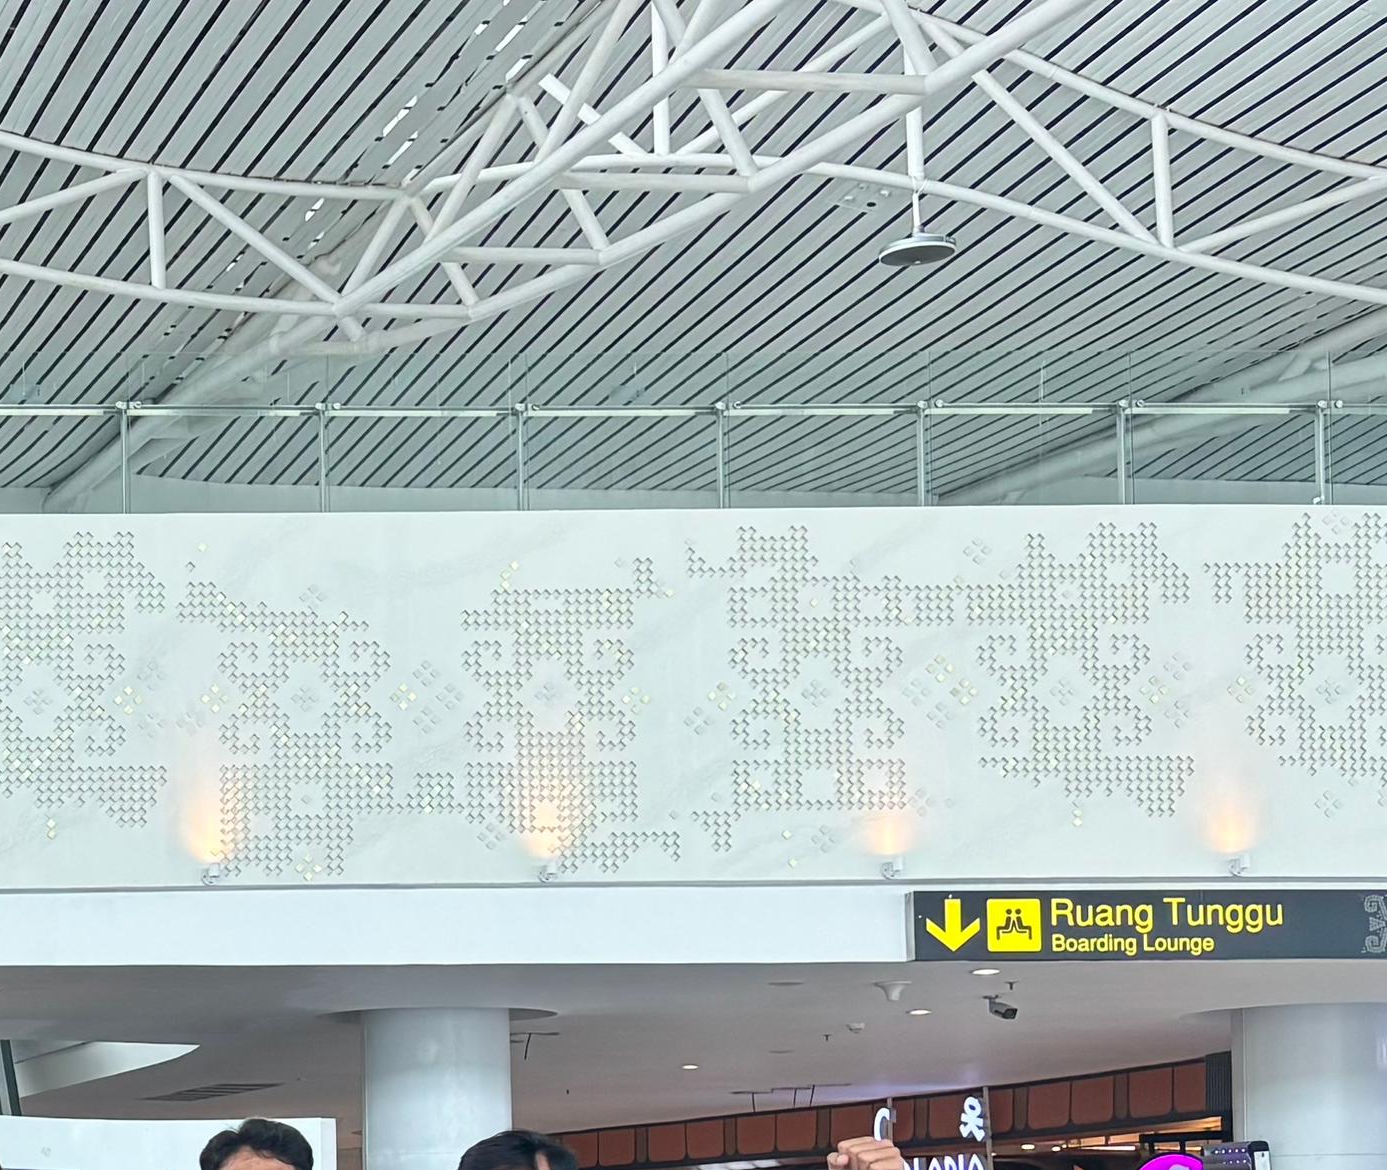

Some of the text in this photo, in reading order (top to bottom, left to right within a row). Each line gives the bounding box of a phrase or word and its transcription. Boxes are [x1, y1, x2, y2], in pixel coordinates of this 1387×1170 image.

[1051, 897, 1283, 934] Ruang Tunggu
[1051, 933, 1215, 956] Boarding Lounge
